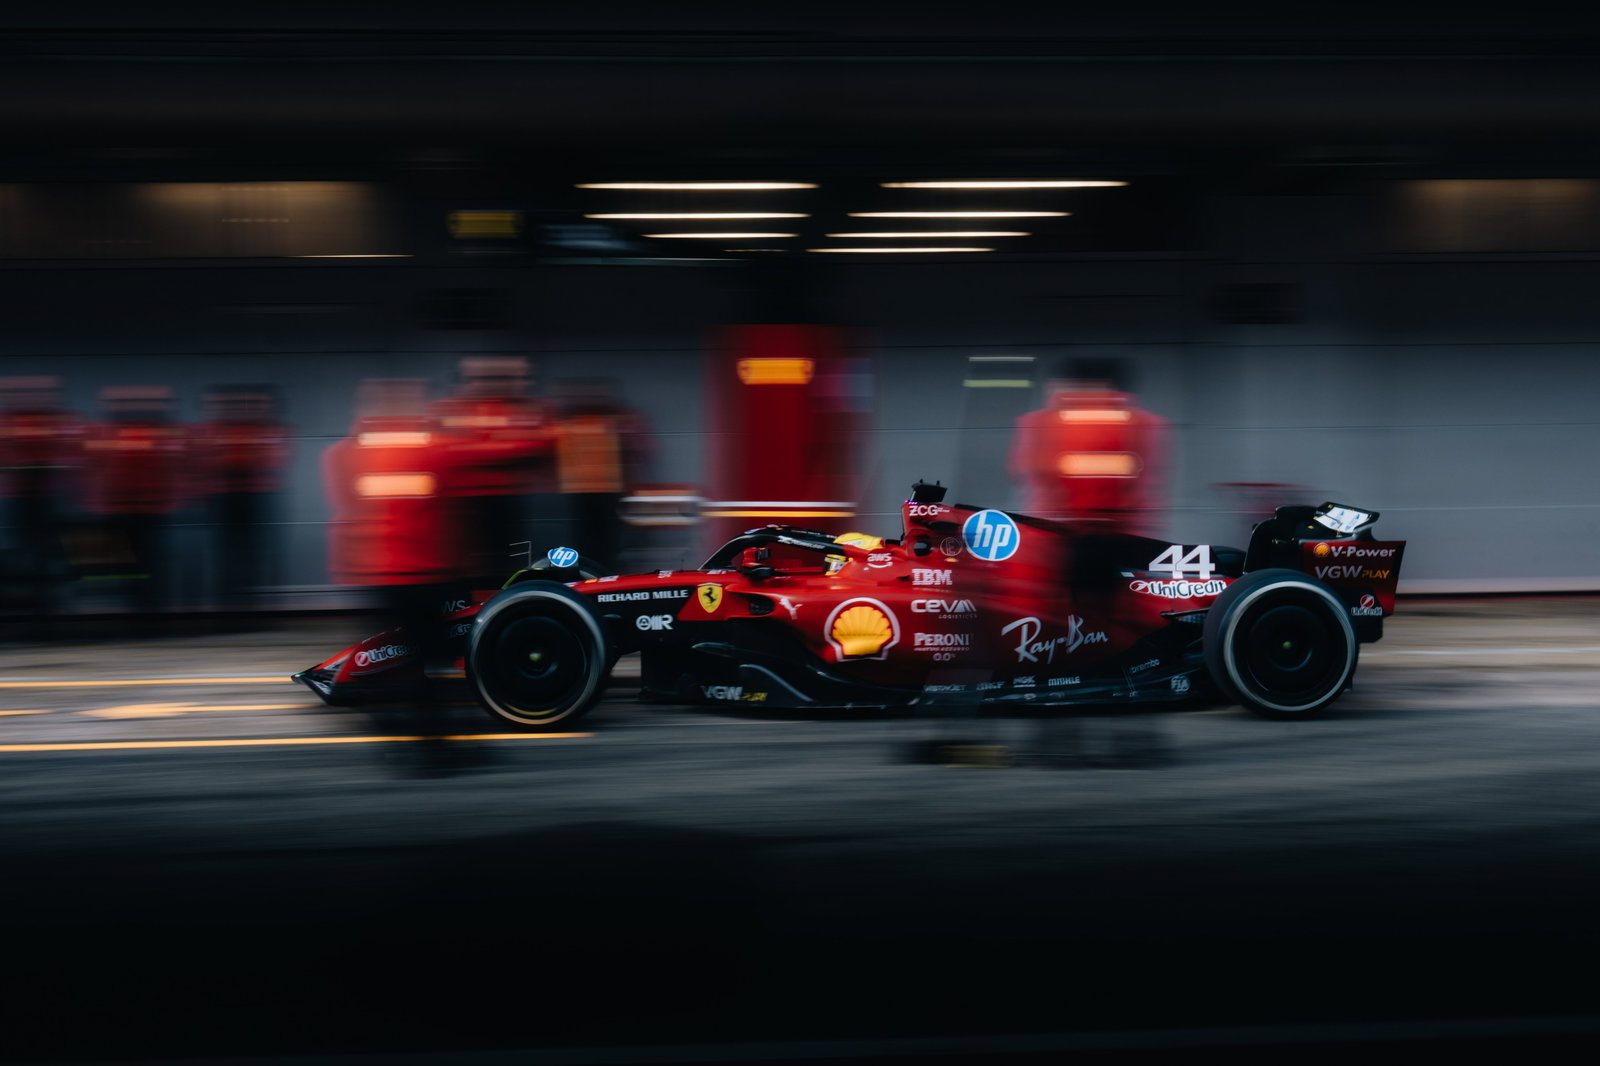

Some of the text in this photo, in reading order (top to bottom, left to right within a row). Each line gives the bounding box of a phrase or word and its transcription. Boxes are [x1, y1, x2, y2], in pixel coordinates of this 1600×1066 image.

[971, 511, 1013, 560] hp
[551, 547, 574, 567] hp
[1330, 545, 1396, 558] V-Power
[1149, 544, 1216, 580] 44
[911, 568, 953, 586] IBM
[1314, 565, 1390, 580] VGW PLAY
[597, 589, 689, 603] RICHARD MILLE
[1149, 580, 1226, 598] UniCredit
[913, 632, 970, 646] PERONI
[1001, 614, 1109, 664] Ray-Ban
